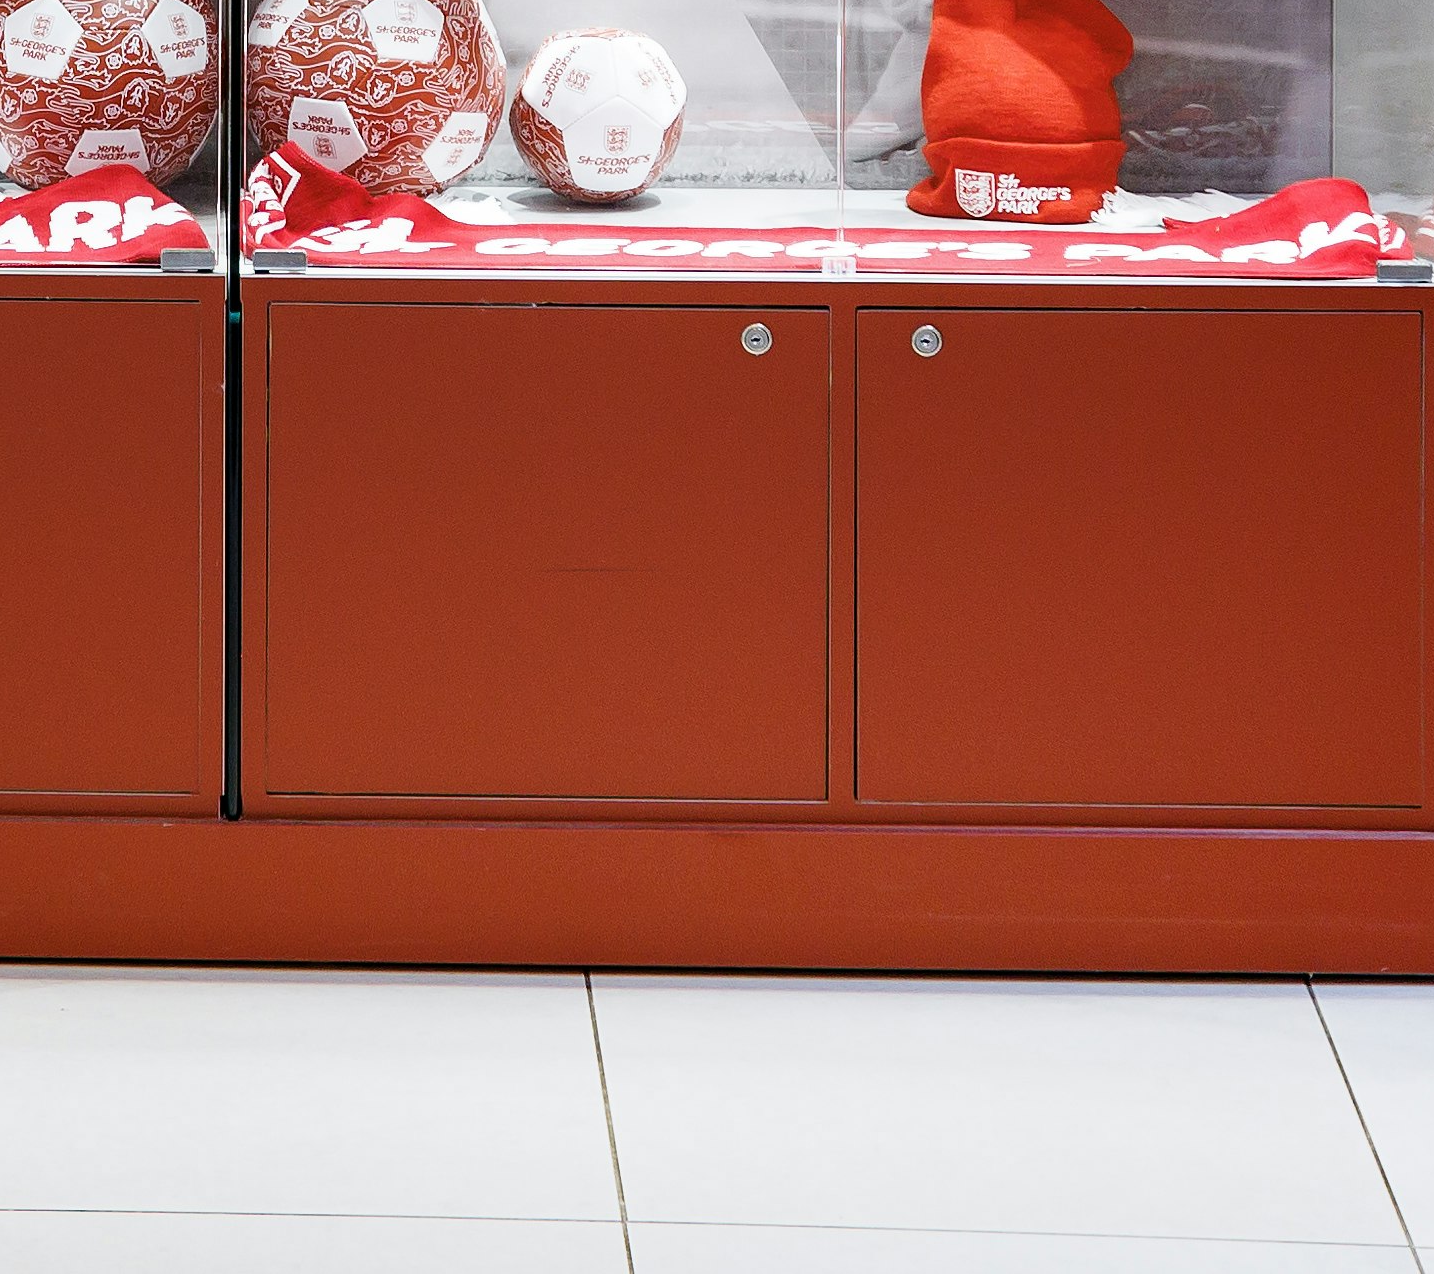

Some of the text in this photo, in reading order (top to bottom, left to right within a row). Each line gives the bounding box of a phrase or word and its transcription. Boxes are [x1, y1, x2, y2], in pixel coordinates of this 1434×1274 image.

[388, 26, 436, 37] GEORGE'S
[171, 37, 205, 51] GEORGE'S
[393, 34, 420, 44] PARK
[19, 39, 66, 56] GEORGE'S
[22, 49, 48, 61] PARK
[176, 50, 197, 60] PARK
[594, 154, 651, 166] GEORGE'S
[997, 187, 1071, 200] GEORGE'S
[998, 200, 1040, 214] PARK
